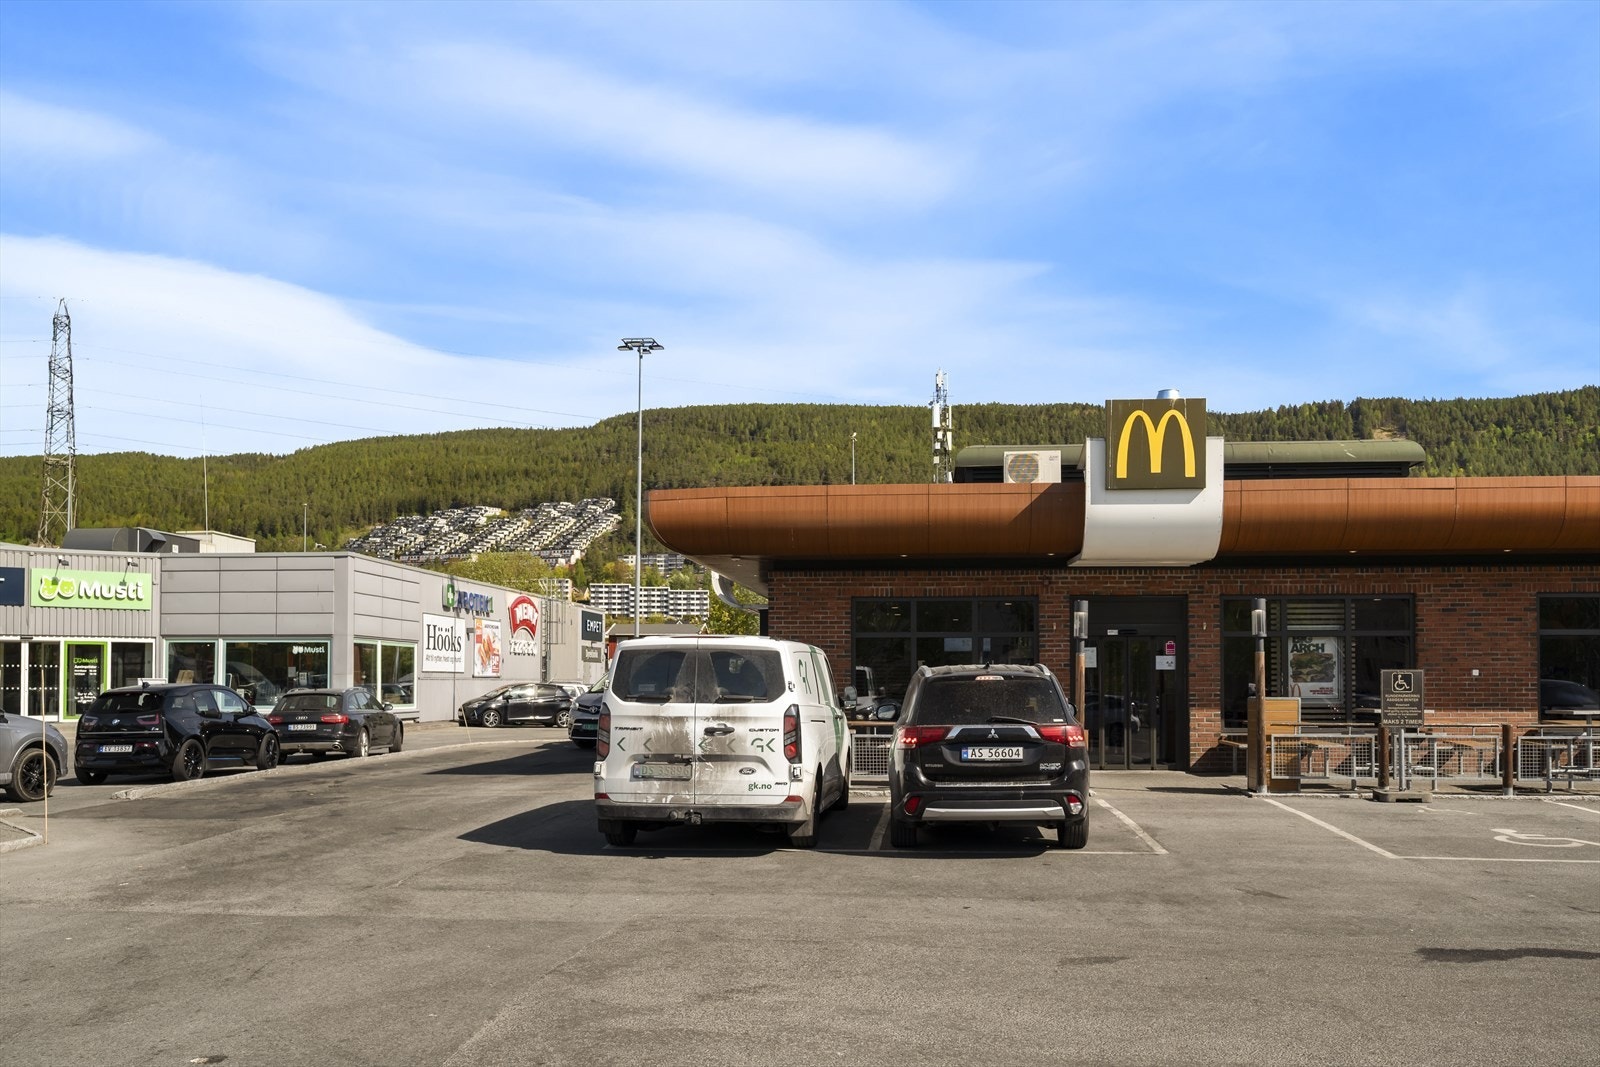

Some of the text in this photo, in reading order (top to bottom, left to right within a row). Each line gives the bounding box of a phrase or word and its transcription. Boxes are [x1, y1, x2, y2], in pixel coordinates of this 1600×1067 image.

[79, 580, 144, 600] Musti
[457, 591, 489, 612] APOTEK
[514, 603, 539, 625] MENY
[426, 624, 462, 653] Hööks
[304, 645, 325, 654] Musti
[1290, 643, 1325, 653] ARCH
[751, 737, 776, 753] GK
[970, 748, 1021, 758] AS 56604
[641, 765, 655, 775] DS
[748, 781, 772, 792] gk.no
